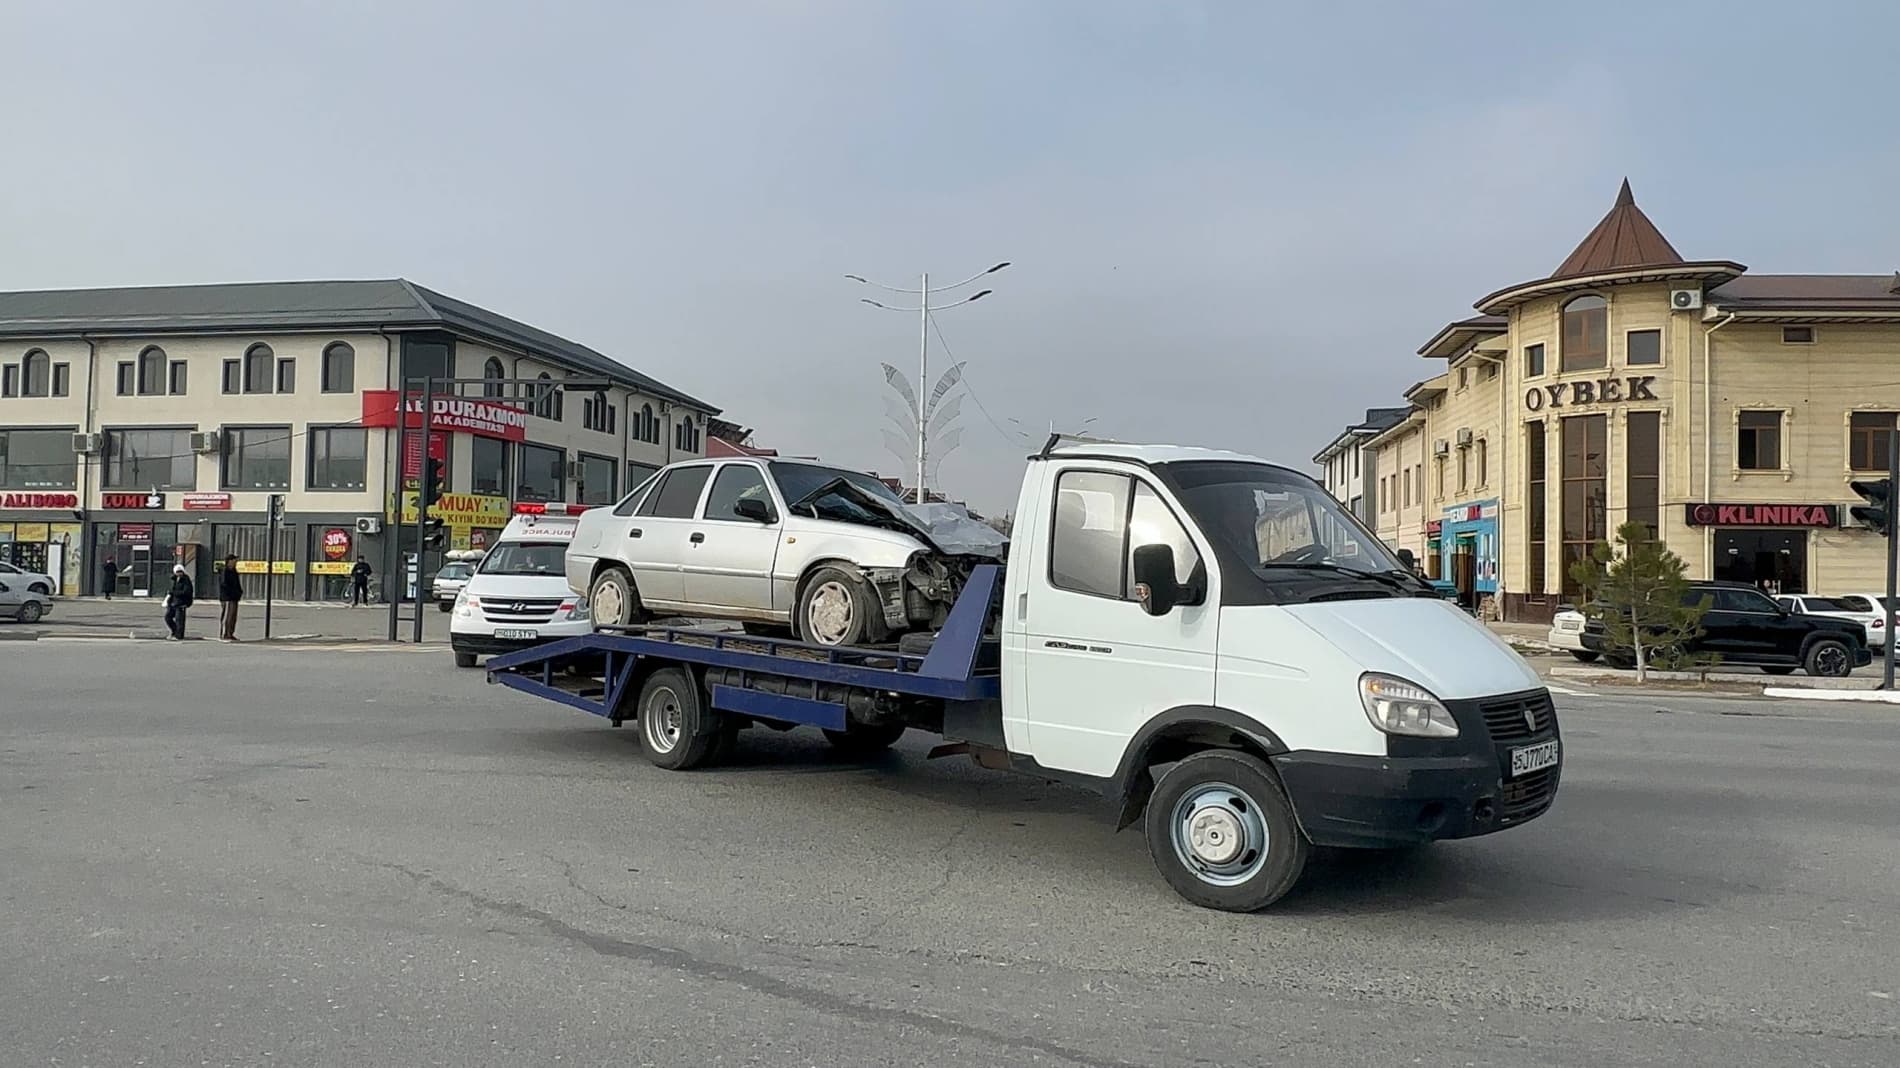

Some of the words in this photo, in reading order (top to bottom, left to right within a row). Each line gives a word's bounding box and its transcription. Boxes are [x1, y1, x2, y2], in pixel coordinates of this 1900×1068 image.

[1525, 376, 1658, 412] OYBEK
[432, 414, 505, 434] AKADEMIYASI
[438, 496, 482, 512] MUAY
[1718, 505, 1829, 525] KLINIKA
